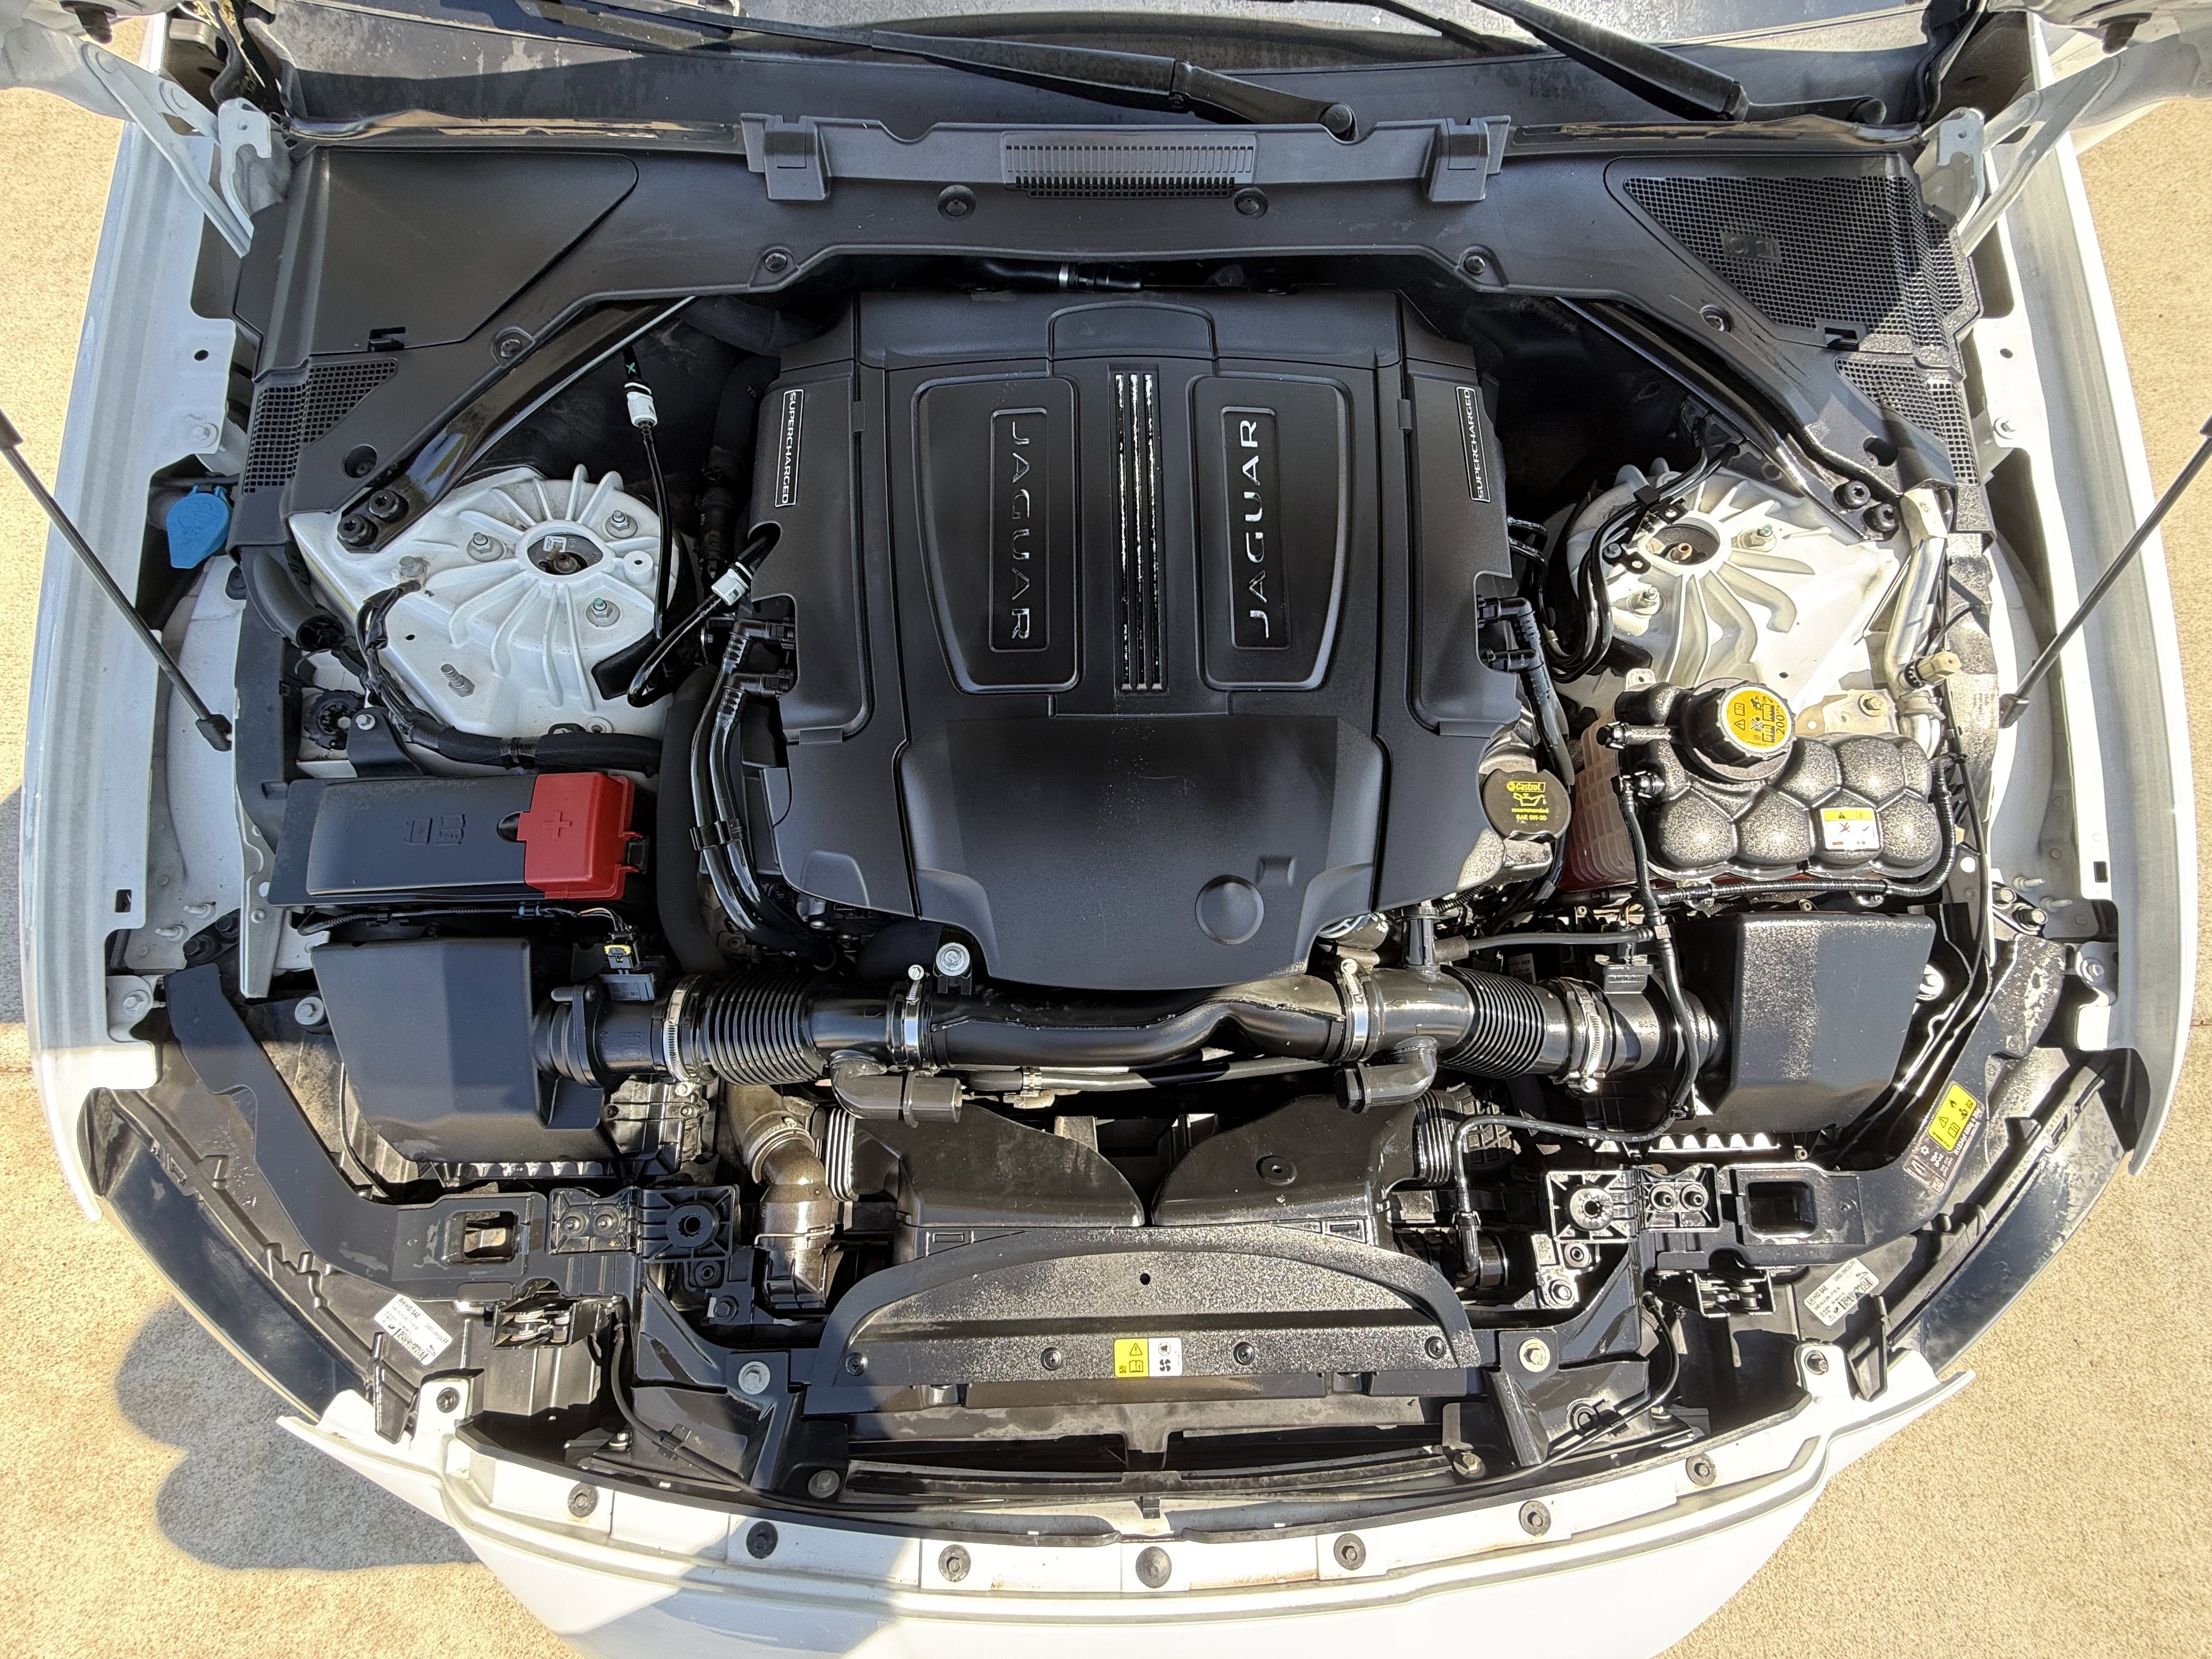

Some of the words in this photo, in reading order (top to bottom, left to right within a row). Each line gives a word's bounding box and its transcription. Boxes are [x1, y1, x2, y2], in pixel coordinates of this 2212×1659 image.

[781, 392, 797, 504] SUPERCHARGED
[1464, 389, 1483, 499] SUPERCHARGED
[1012, 421, 1030, 640] JAGUAR
[1240, 420, 1269, 639] JAGUAR
[1776, 714, 1785, 734] 200
[1516, 782, 1541, 791] Castrol
